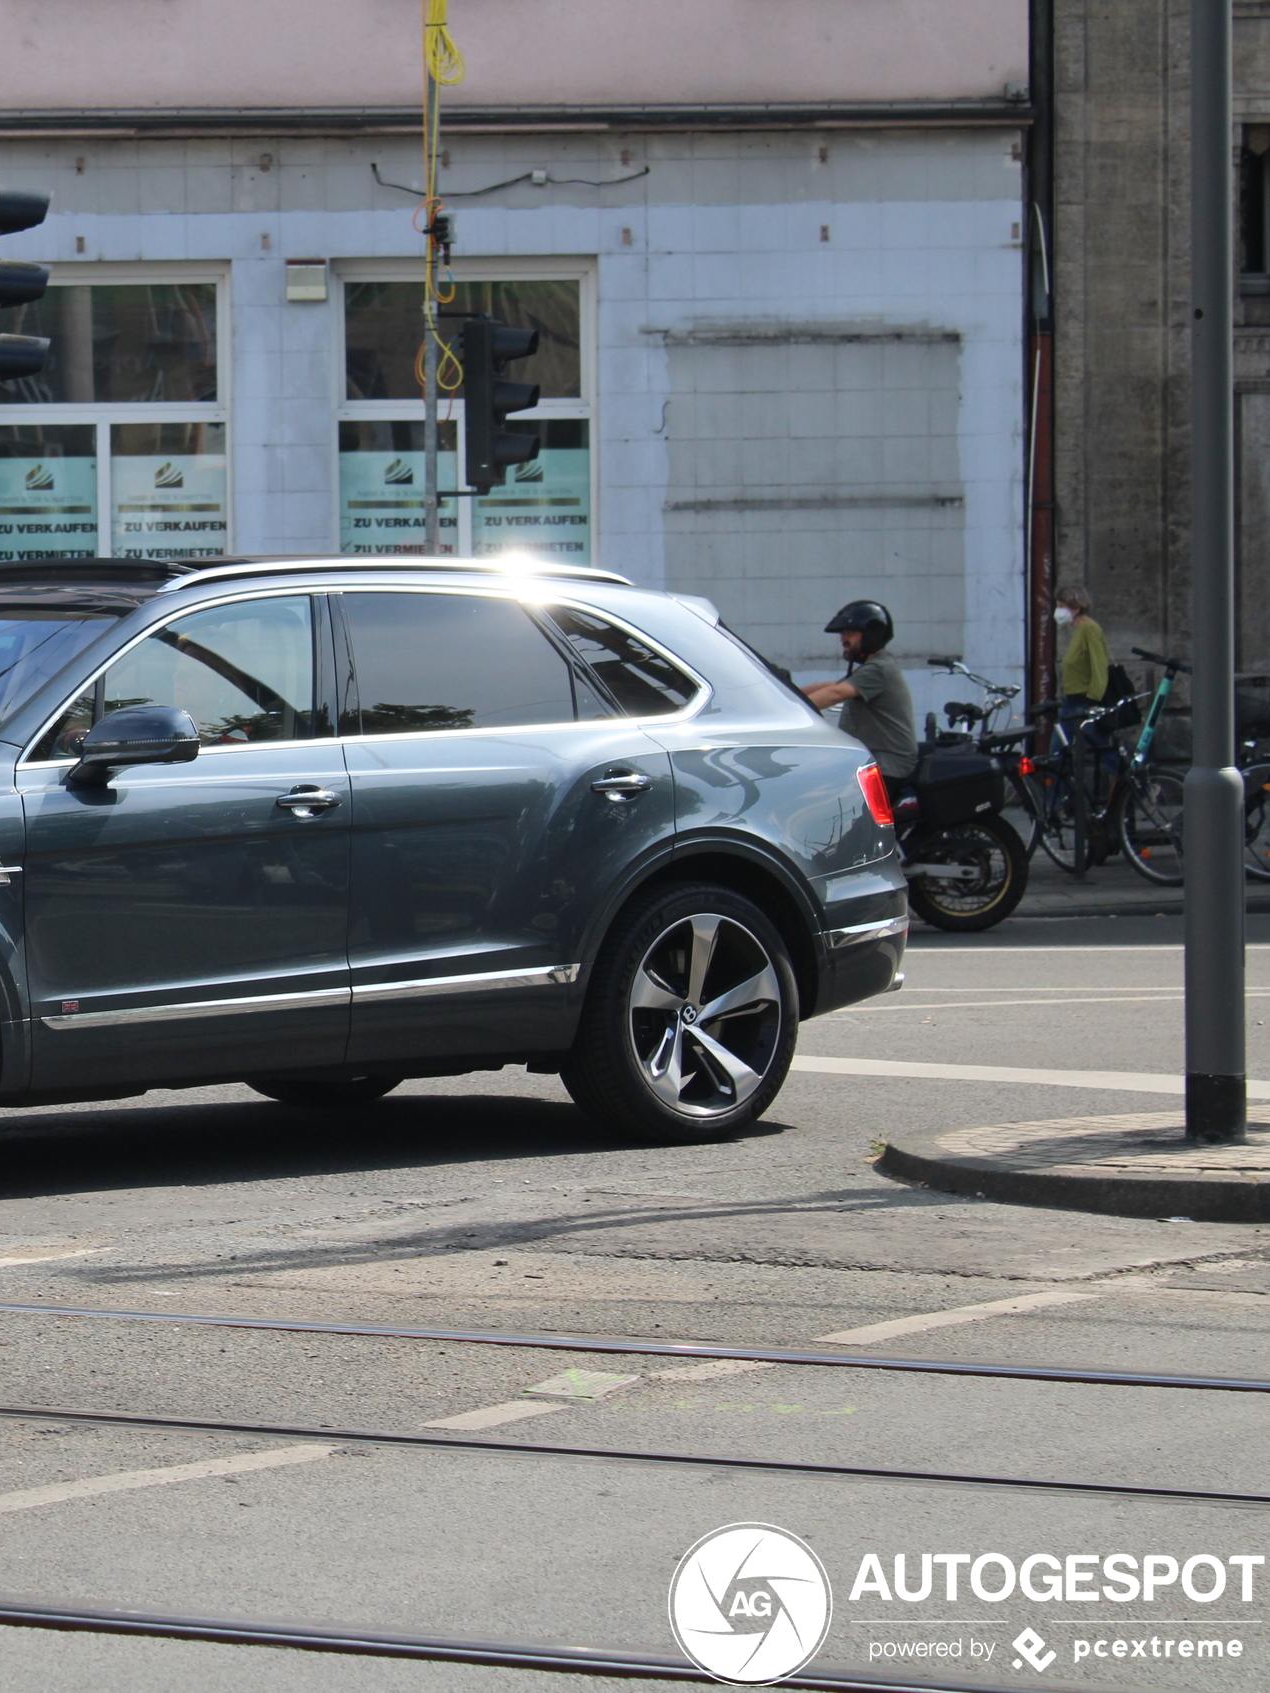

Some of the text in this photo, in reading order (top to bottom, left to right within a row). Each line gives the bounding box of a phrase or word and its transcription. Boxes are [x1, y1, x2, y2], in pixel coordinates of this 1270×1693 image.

[125, 520, 227, 532] ZU VERKAUFEN
[353, 517, 457, 528] ZU VERKAEN
[484, 515, 588, 527] ZU VERKAUFEN
[17, 522, 98, 534] VERKAUFEN
[125, 548, 224, 559] ZU VERMIETEN
[353, 544, 453, 554] ZU VERMIEEN
[484, 543, 502, 553] ZU
[18, 549, 95, 561] VERMIETEN
